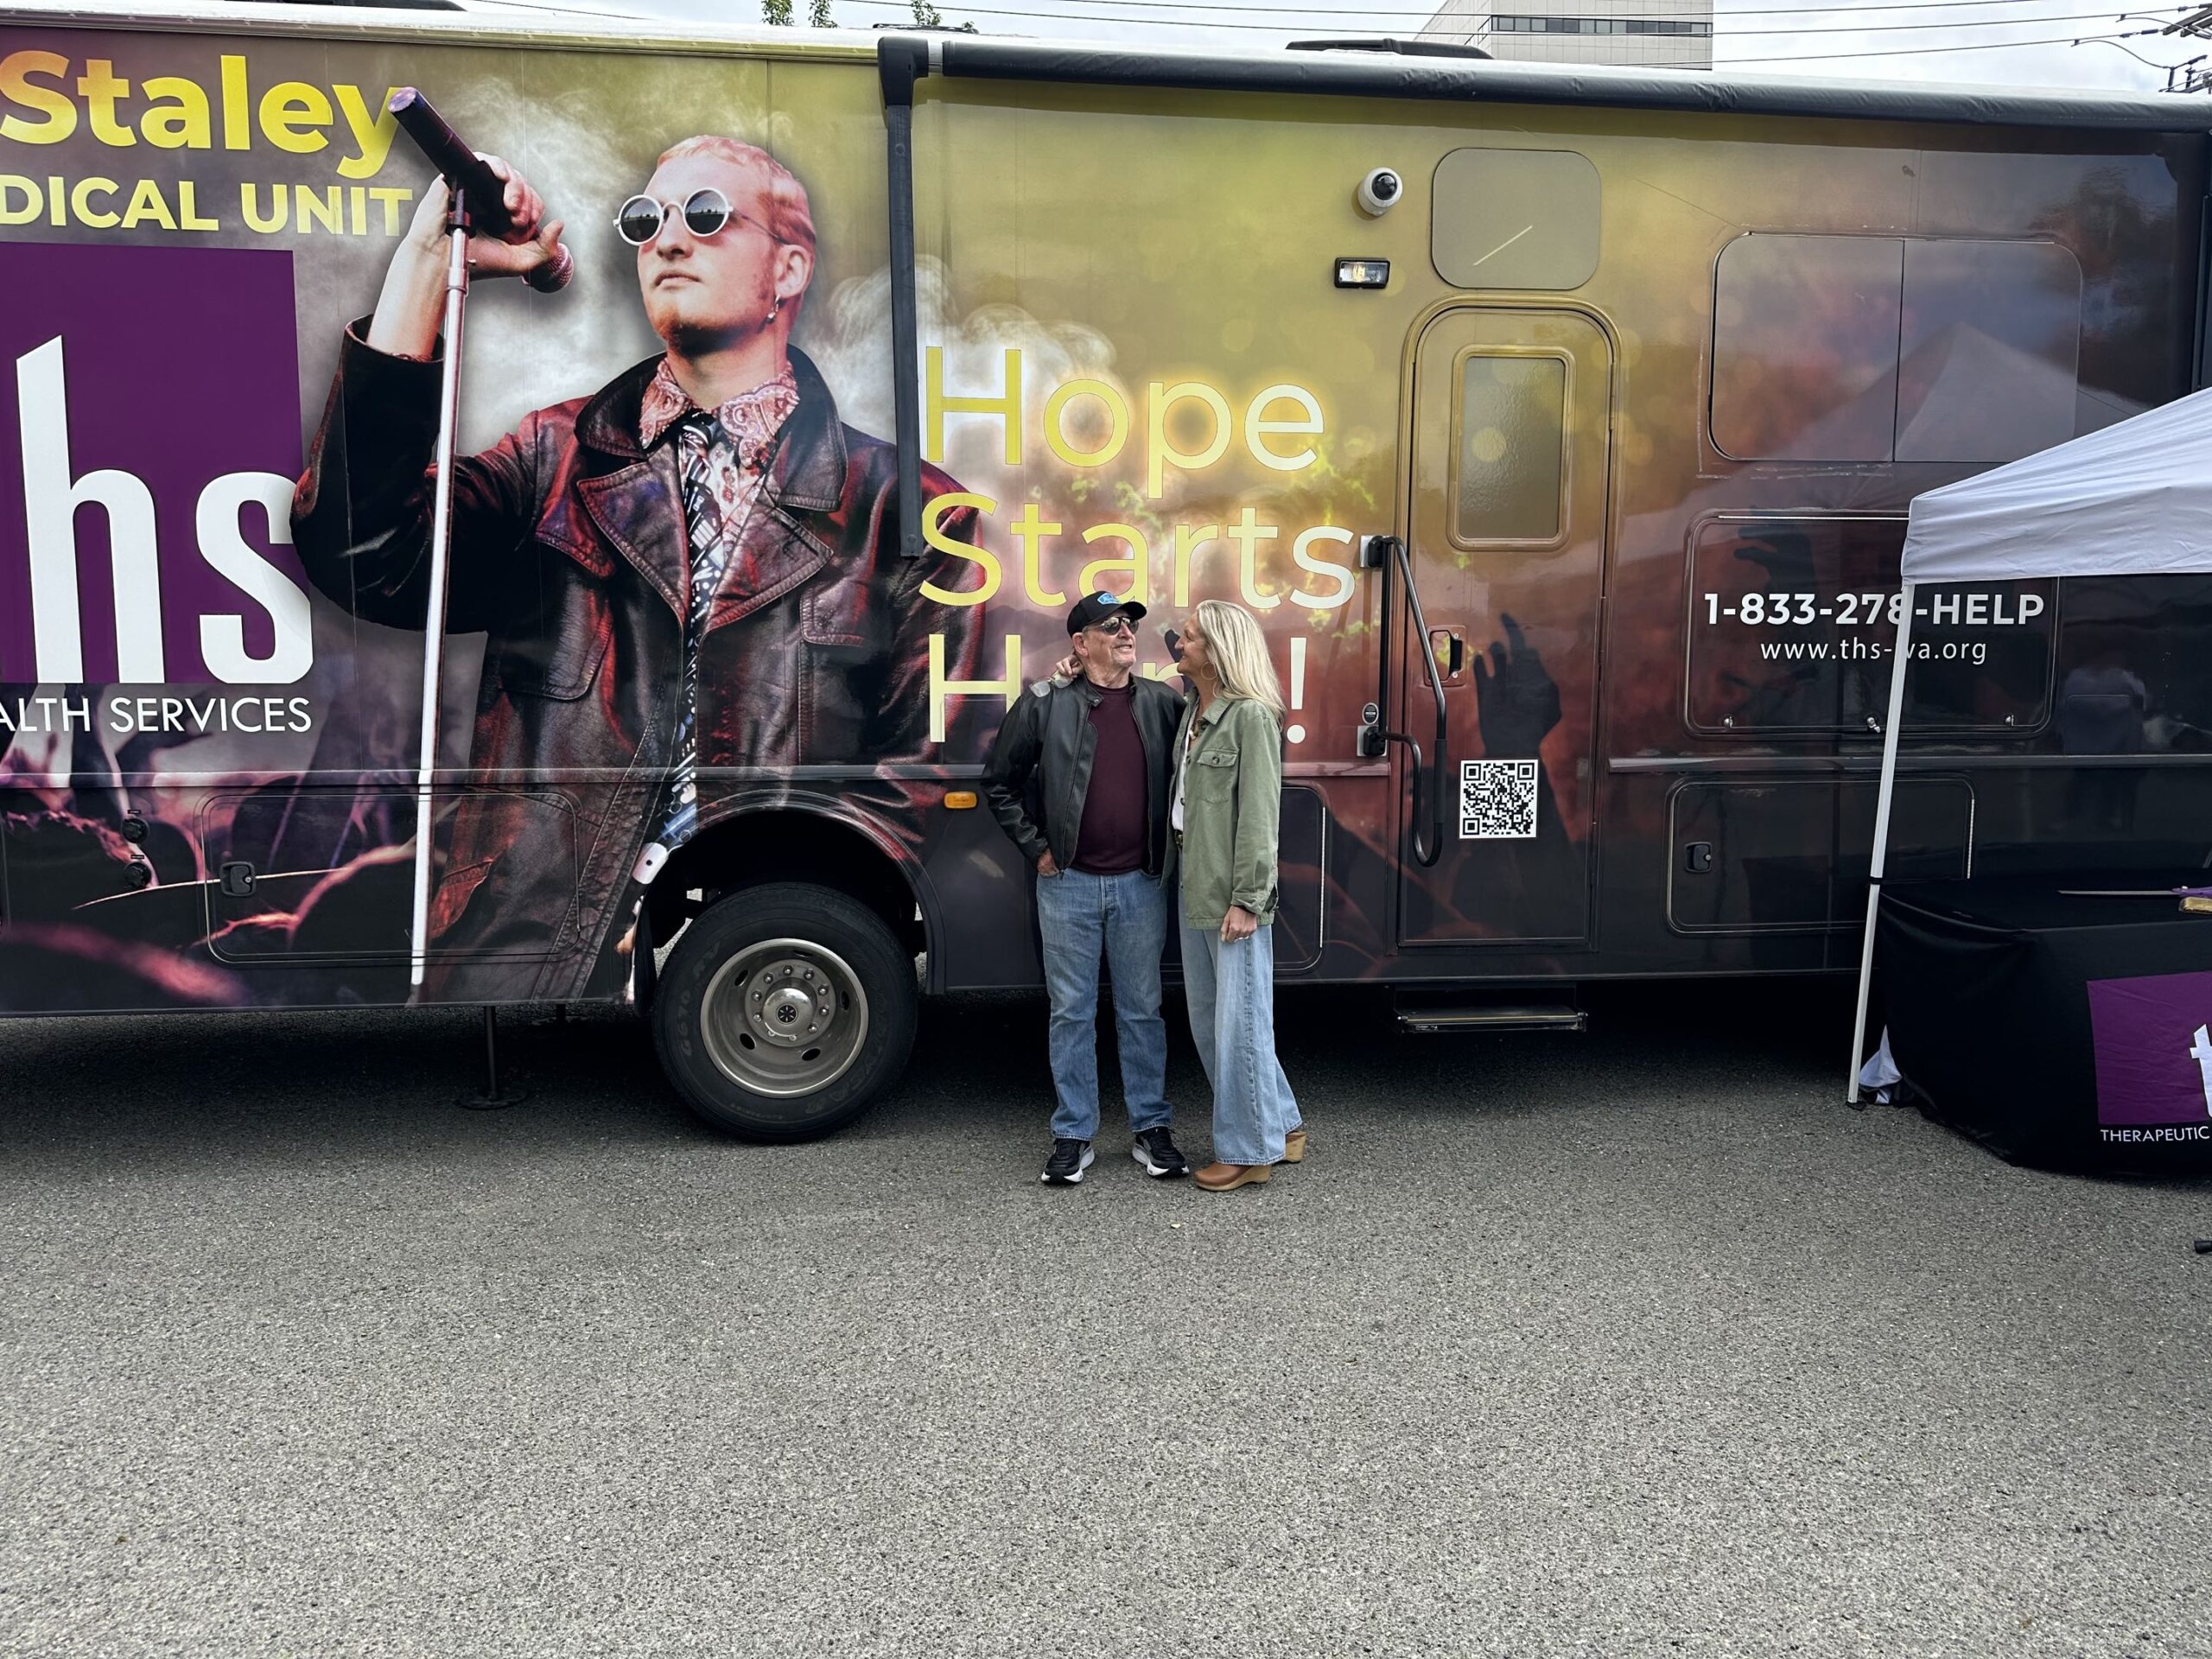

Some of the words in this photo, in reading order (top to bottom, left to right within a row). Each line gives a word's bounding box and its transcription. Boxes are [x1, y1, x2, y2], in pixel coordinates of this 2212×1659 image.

[0, 50, 401, 180] Staley
[0, 174, 219, 232] DICAL
[240, 182, 413, 238] UNIT
[925, 346, 1325, 499] Hope
[918, 492, 1357, 610] Starts
[1704, 593, 2044, 626] 1-833-278-HELP
[110, 696, 312, 734] SERVICES
[2100, 1126, 2210, 1141] THERAPEUTIC
